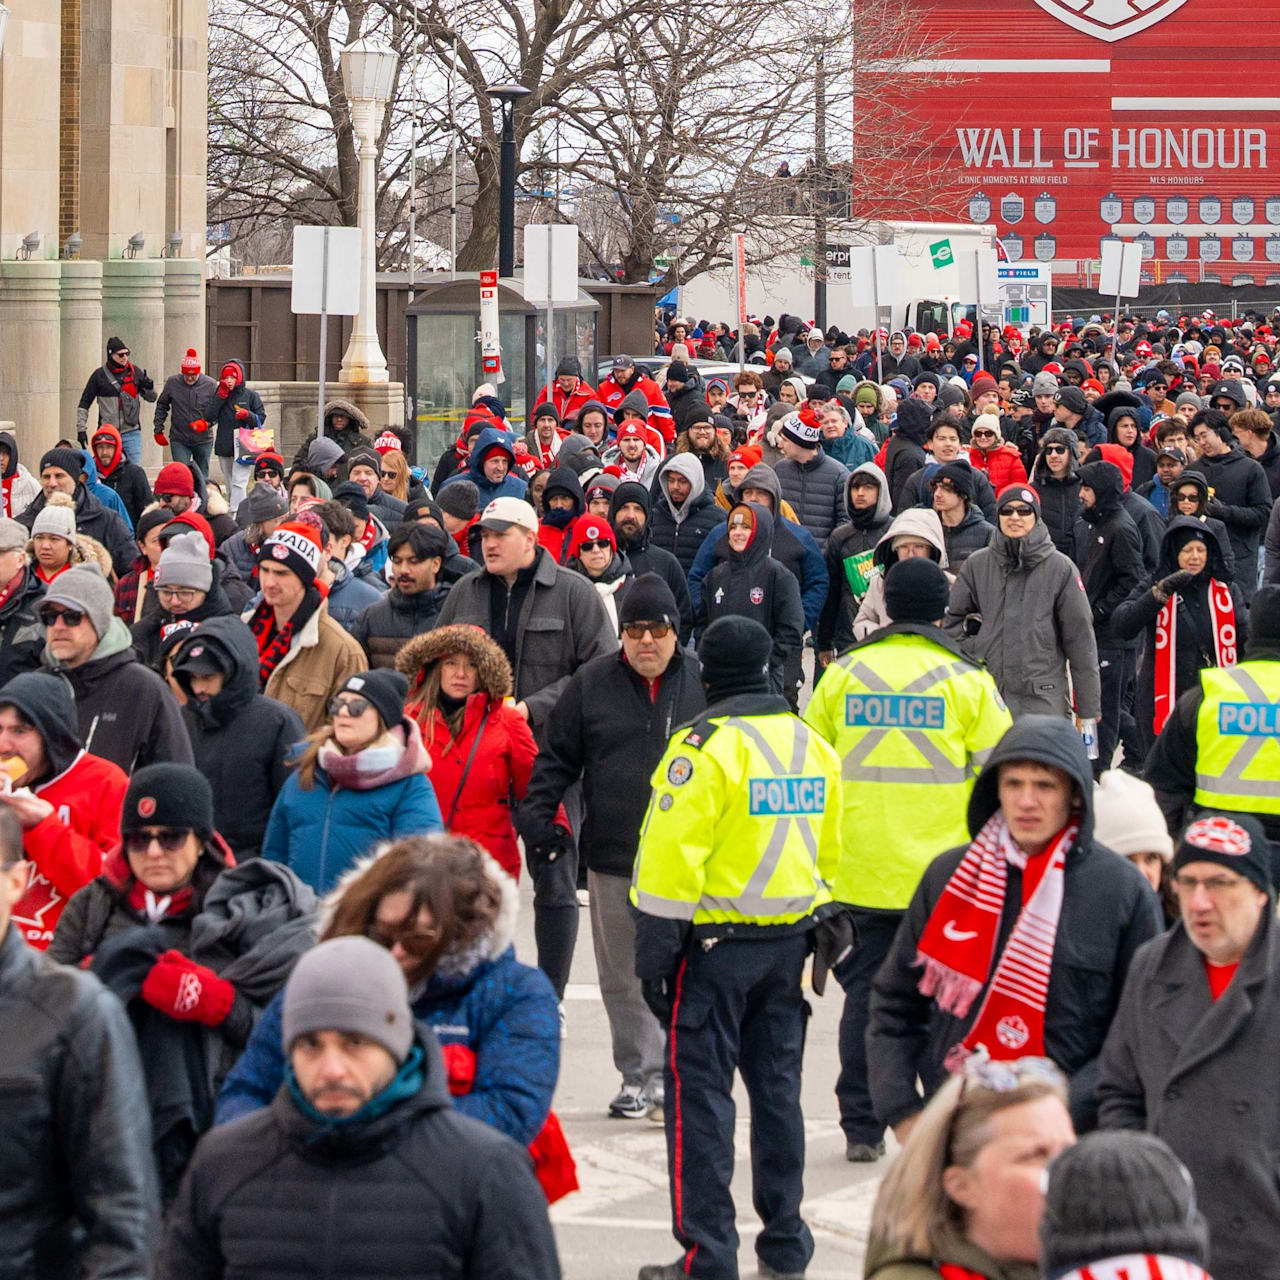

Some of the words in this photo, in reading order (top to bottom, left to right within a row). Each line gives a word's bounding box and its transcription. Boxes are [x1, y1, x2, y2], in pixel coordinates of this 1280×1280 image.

[955, 127, 1053, 169] WALL
[1064, 127, 1100, 160] OF
[1111, 127, 1268, 169] HONOUR
[958, 175, 981, 185] ICONIC
[982, 175, 1018, 185] MOMENTS
[1019, 175, 1028, 185] AT
[1030, 175, 1045, 185] BMO
[1047, 175, 1068, 185] FIELD
[1149, 176, 1166, 185] MLS
[1167, 176, 1205, 185] HONOURS
[834, 270, 851, 280] rent
[847, 696, 942, 727] POLICE
[750, 780, 824, 813] POLICE
